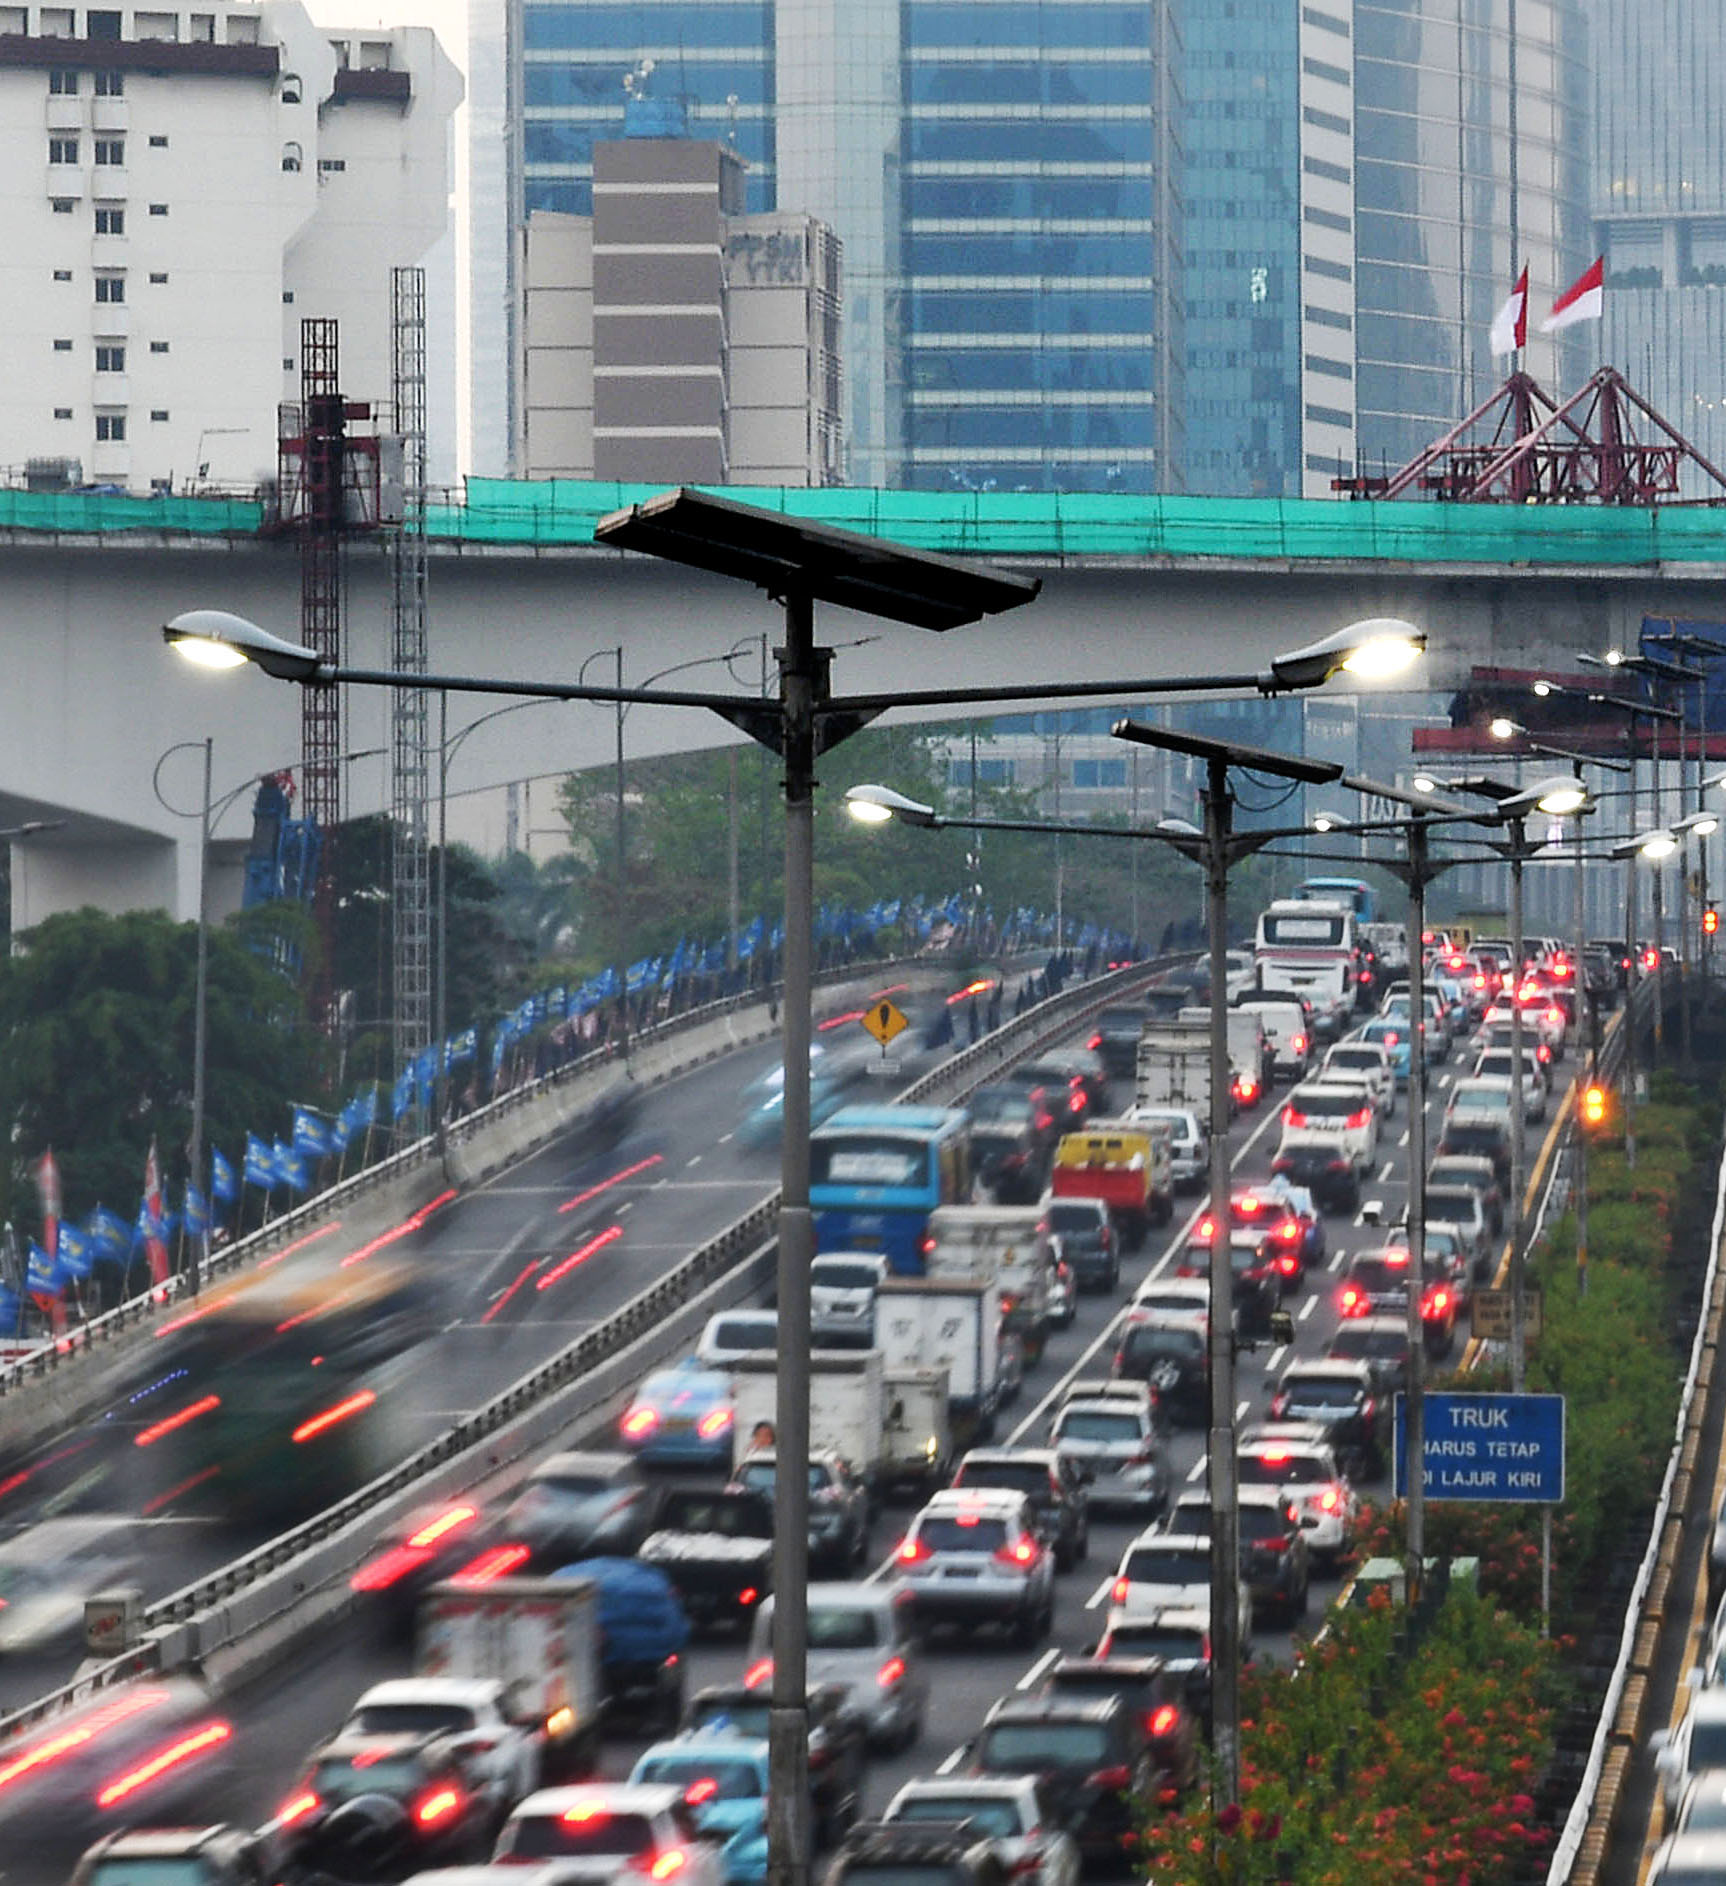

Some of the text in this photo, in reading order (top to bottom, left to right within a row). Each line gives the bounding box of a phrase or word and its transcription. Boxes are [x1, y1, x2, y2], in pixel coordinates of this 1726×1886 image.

[1448, 1407, 1509, 1428] TRUK
[1486, 1442, 1541, 1457] TETAP
[1441, 1470, 1498, 1487] LAJUR
[1507, 1471, 1542, 1488] KIRI
